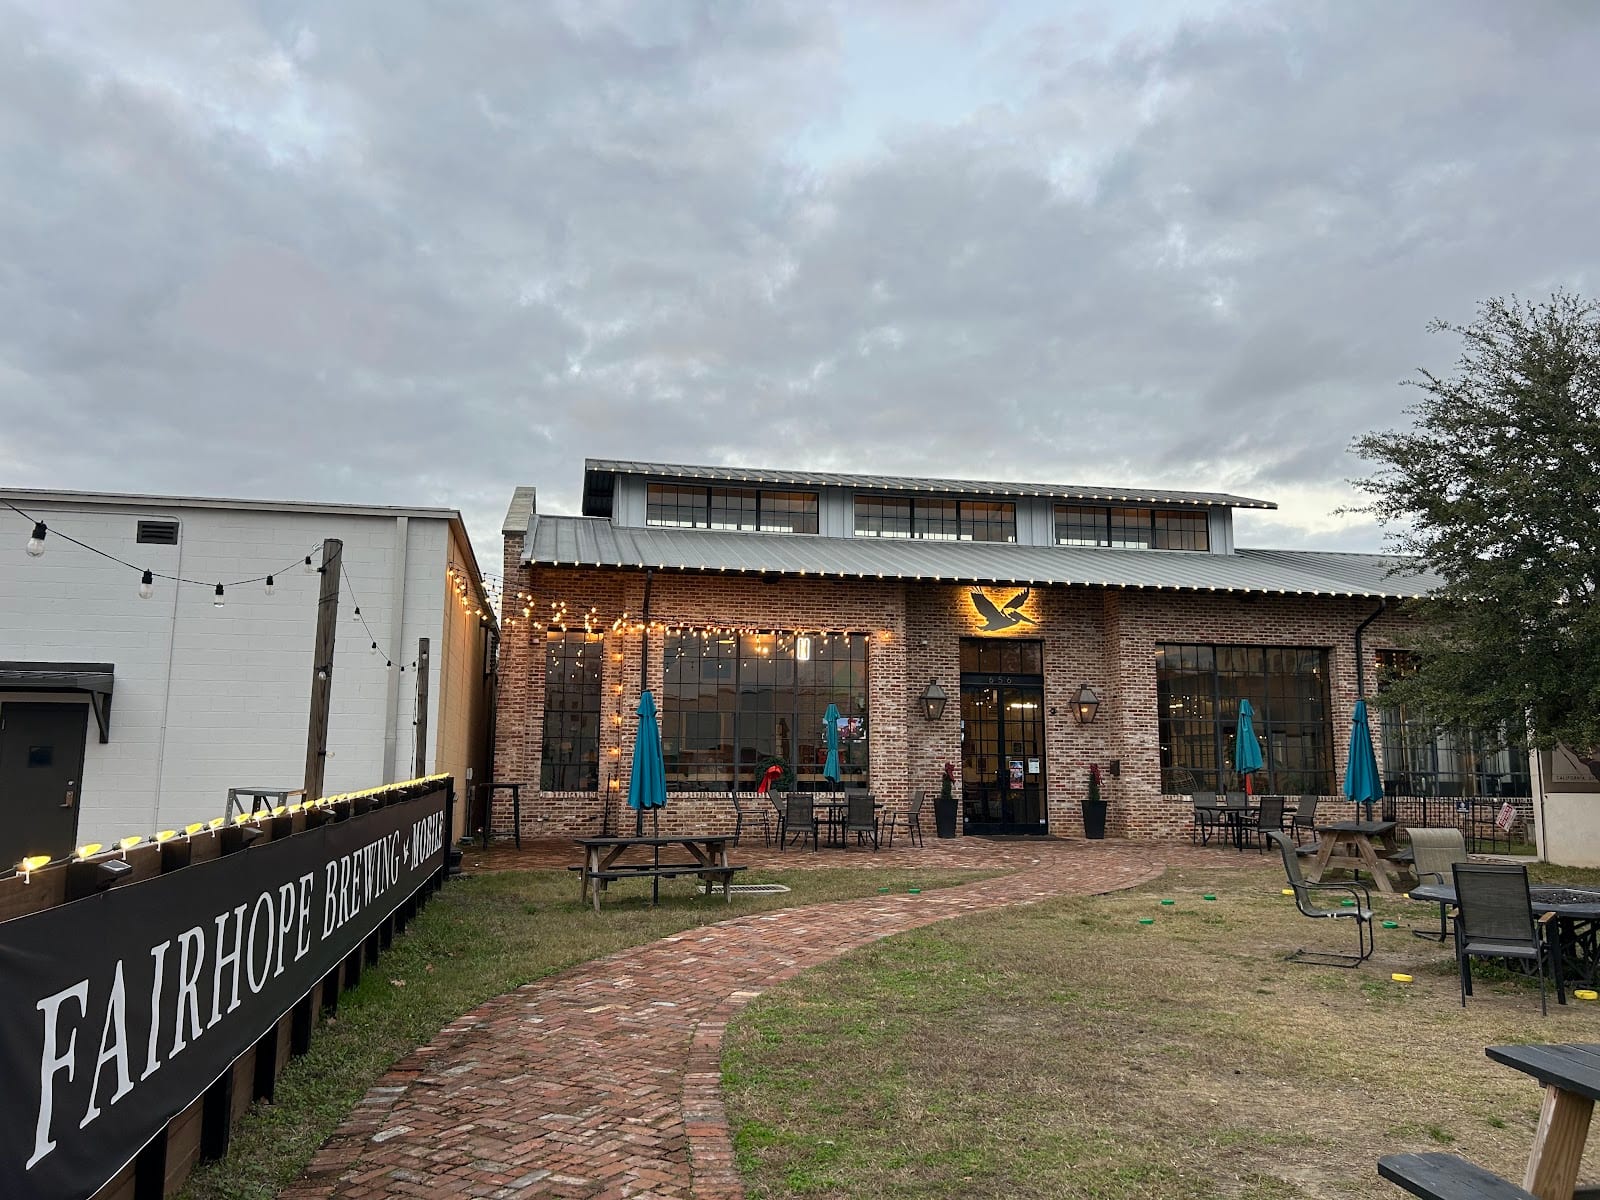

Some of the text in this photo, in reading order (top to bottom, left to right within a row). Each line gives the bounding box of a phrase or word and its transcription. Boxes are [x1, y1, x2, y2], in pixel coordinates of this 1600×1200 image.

[989, 676, 1012, 684] 656
[26, 810, 444, 1171] FAIRHOPE BREWING MOBILE
